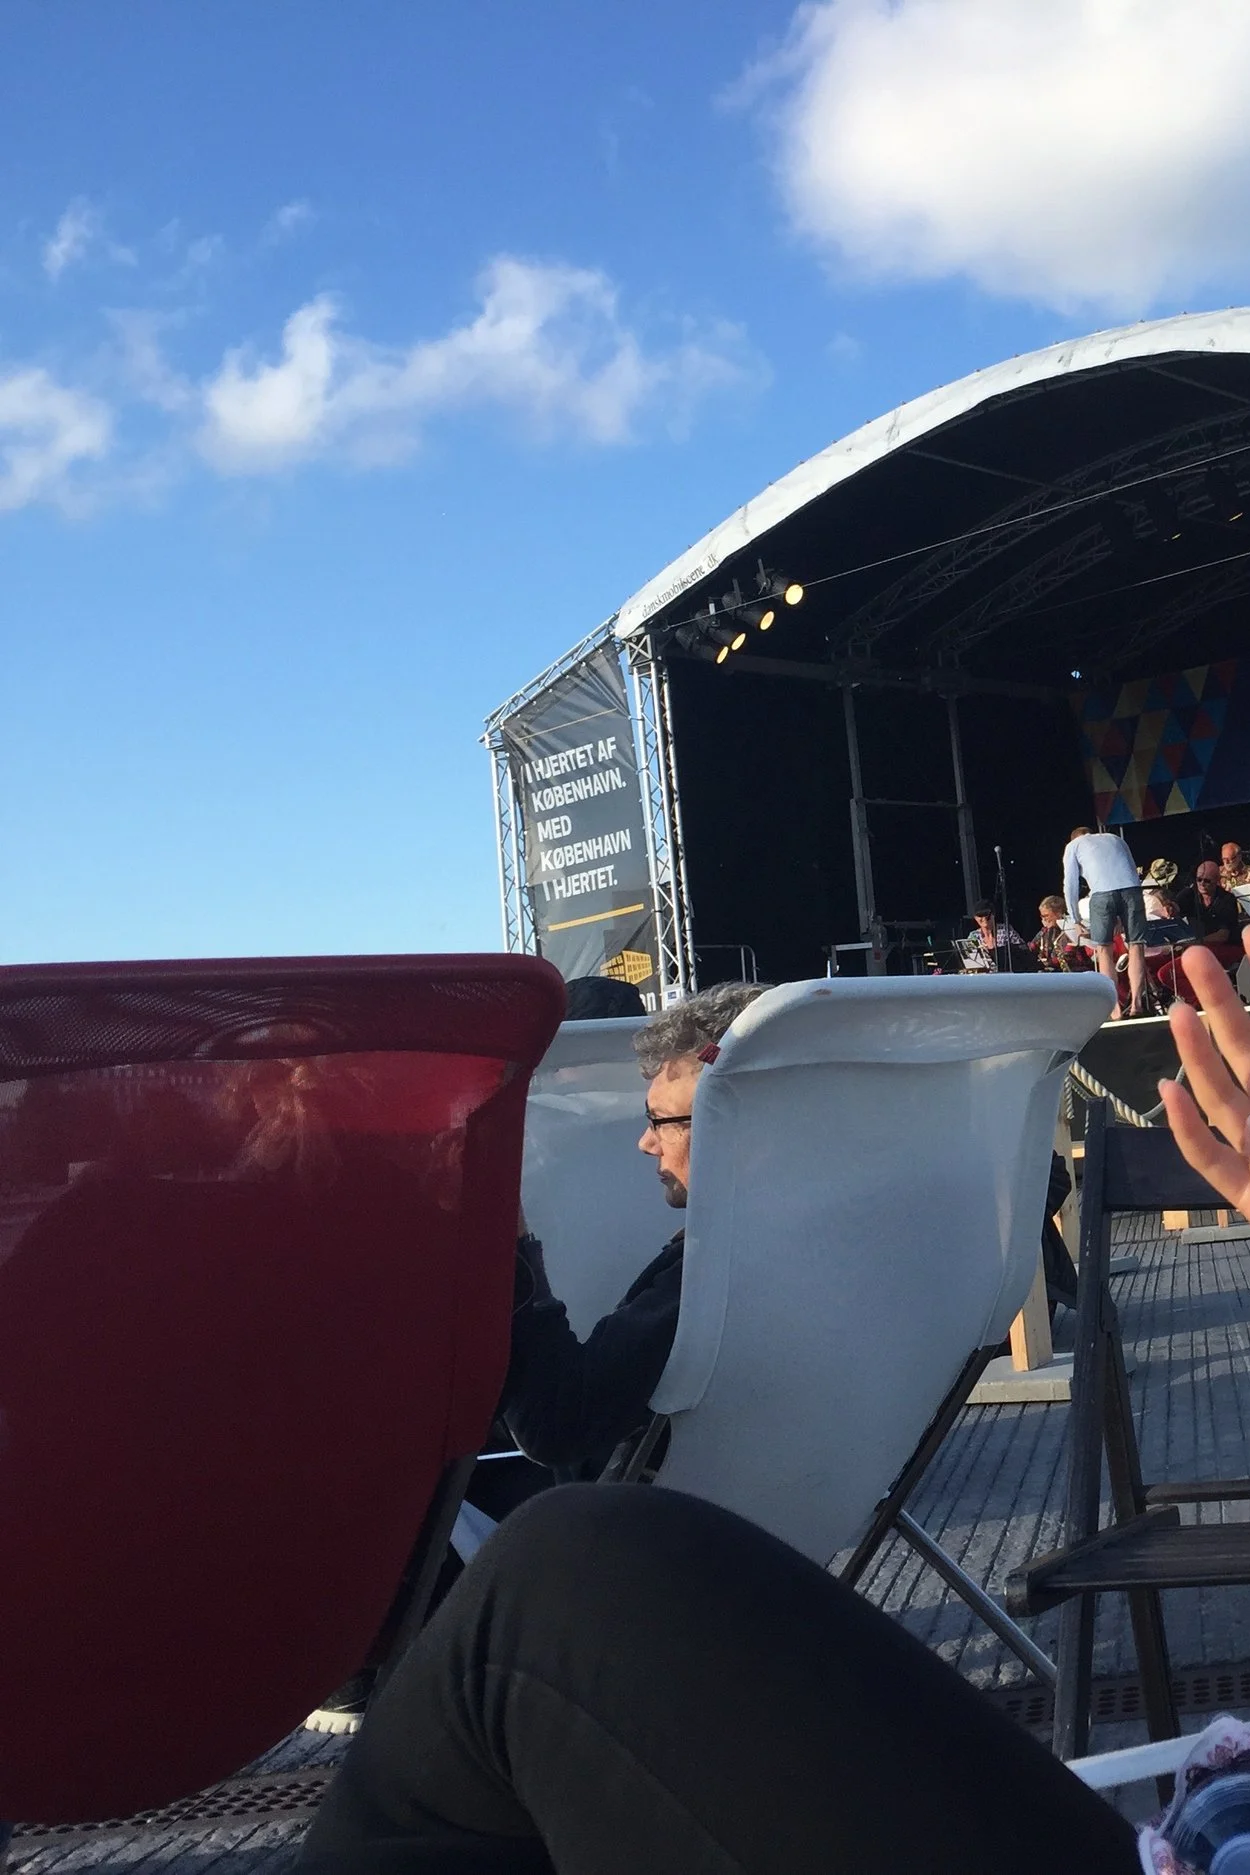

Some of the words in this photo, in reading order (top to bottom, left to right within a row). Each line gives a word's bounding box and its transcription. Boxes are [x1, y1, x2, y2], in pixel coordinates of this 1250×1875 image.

[524, 762, 533, 783] I
[534, 743, 594, 780] HJERTET
[598, 737, 618, 763] AF
[531, 767, 627, 813] KØBENHAVN.
[537, 815, 573, 843] MED
[540, 829, 632, 872] KØBENHAVN
[542, 880, 551, 902] I
[554, 865, 618, 900] HJERTET.
